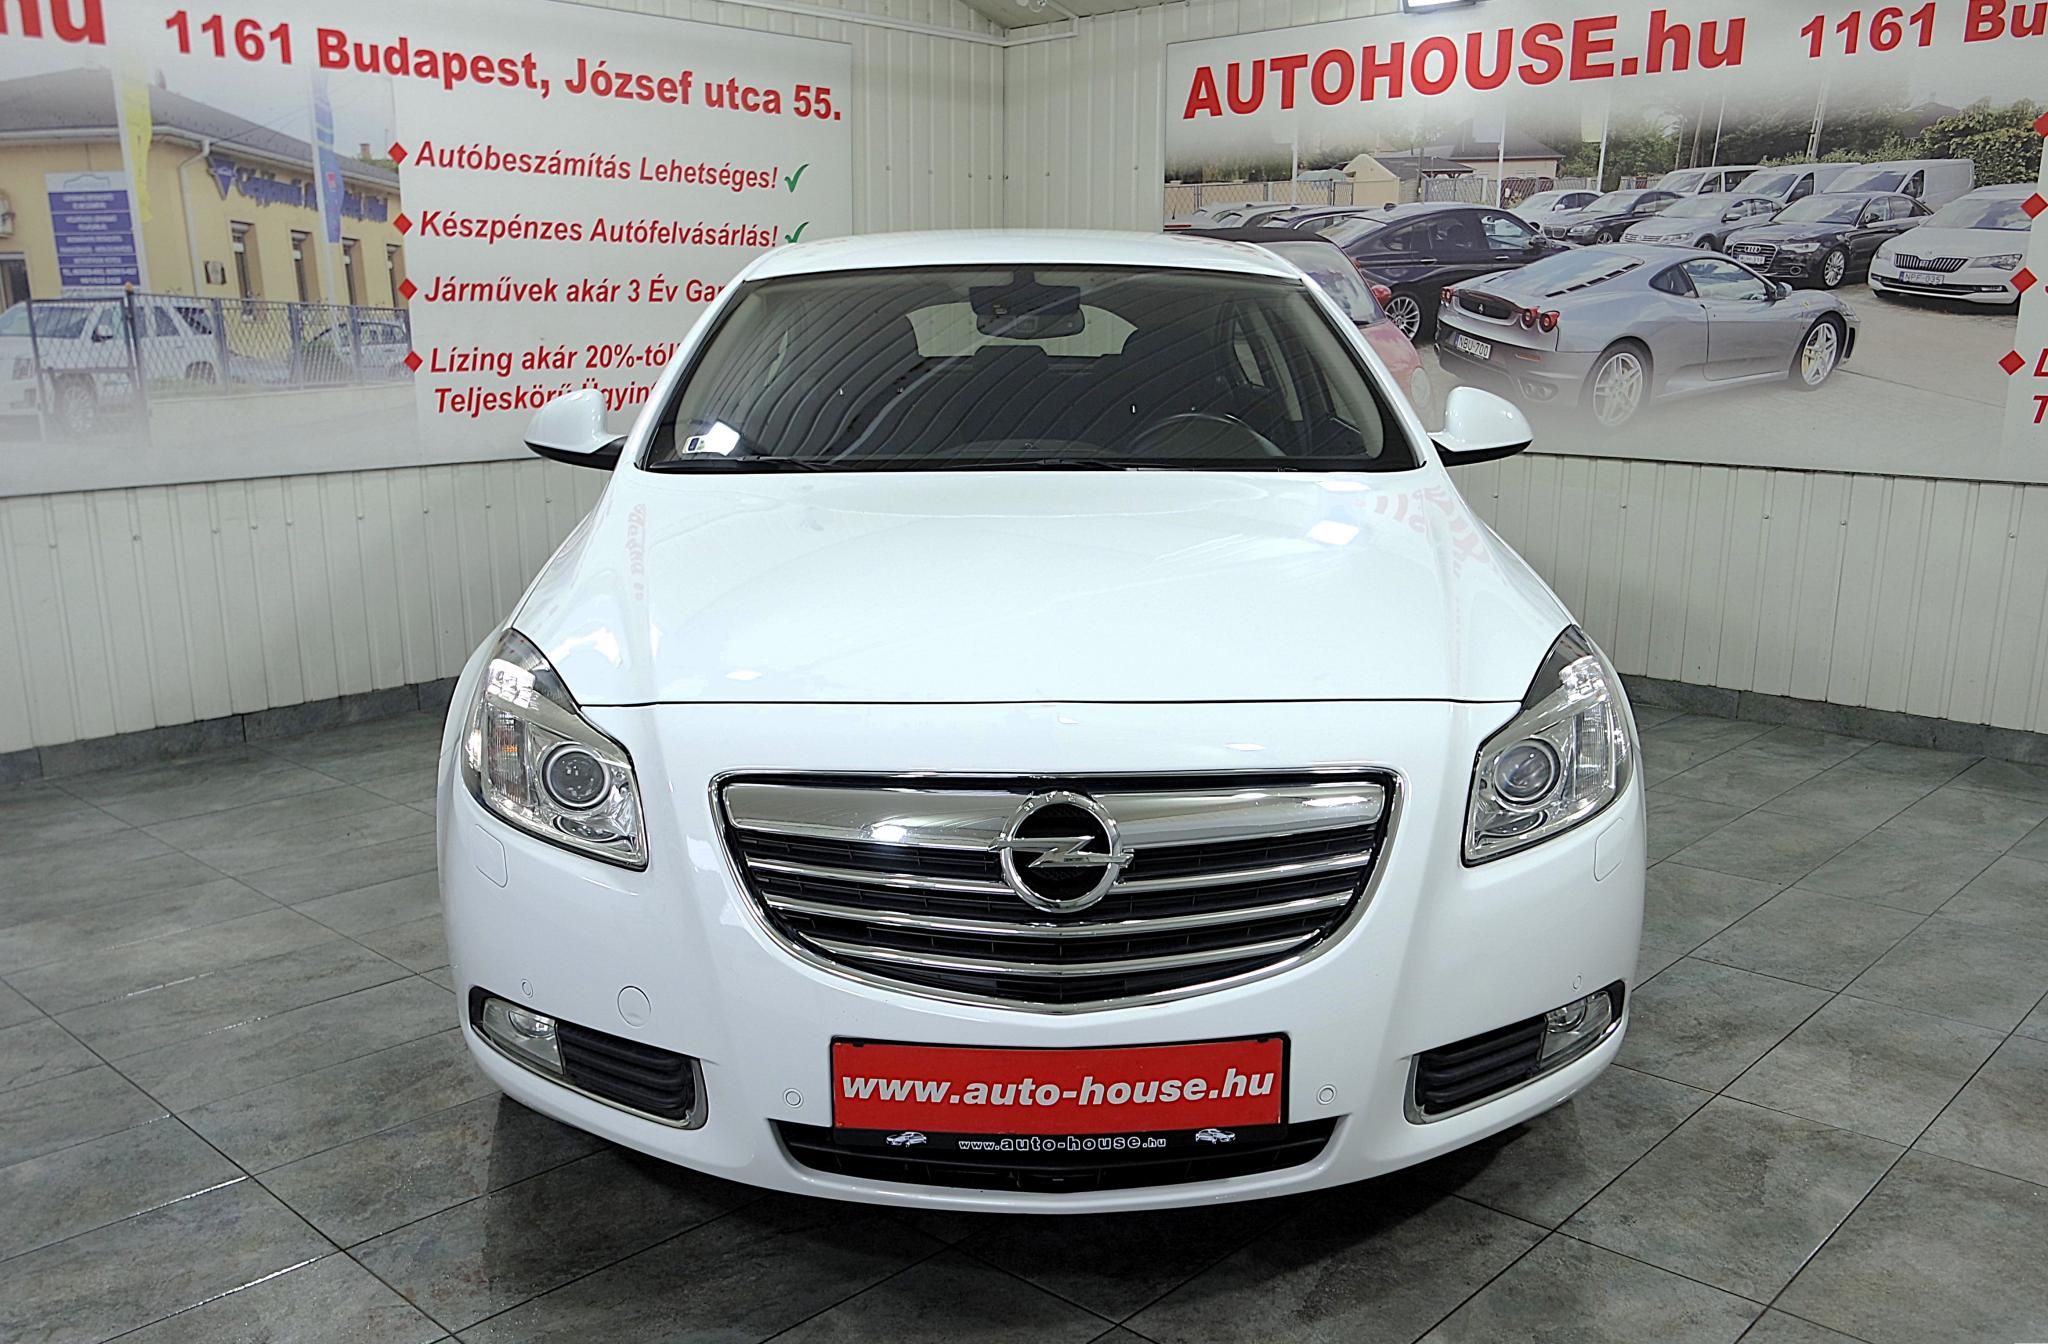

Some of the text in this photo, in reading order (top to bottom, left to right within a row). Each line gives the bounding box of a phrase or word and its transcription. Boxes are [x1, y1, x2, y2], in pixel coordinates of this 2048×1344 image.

[1799, 0, 1937, 59] 1161
[165, 9, 842, 121] 1161 Budapest, József utca 55.
[1183, 8, 1746, 120] AUTOHOUSE.hu
[415, 140, 778, 193] Autóbeszámítás Lehetséges!
[419, 210, 778, 248] Készpénzes Autófelvásárlás!
[424, 275, 558, 303] Járművek
[565, 278, 621, 303] akár
[628, 278, 641, 303] 3
[647, 273, 679, 303] Év
[430, 345, 514, 378] Lízing
[521, 344, 579, 371] akár
[842, 1067, 1275, 1107] www.auto-house.hu
[958, 1136, 1167, 1151] www.auto-house.hu
